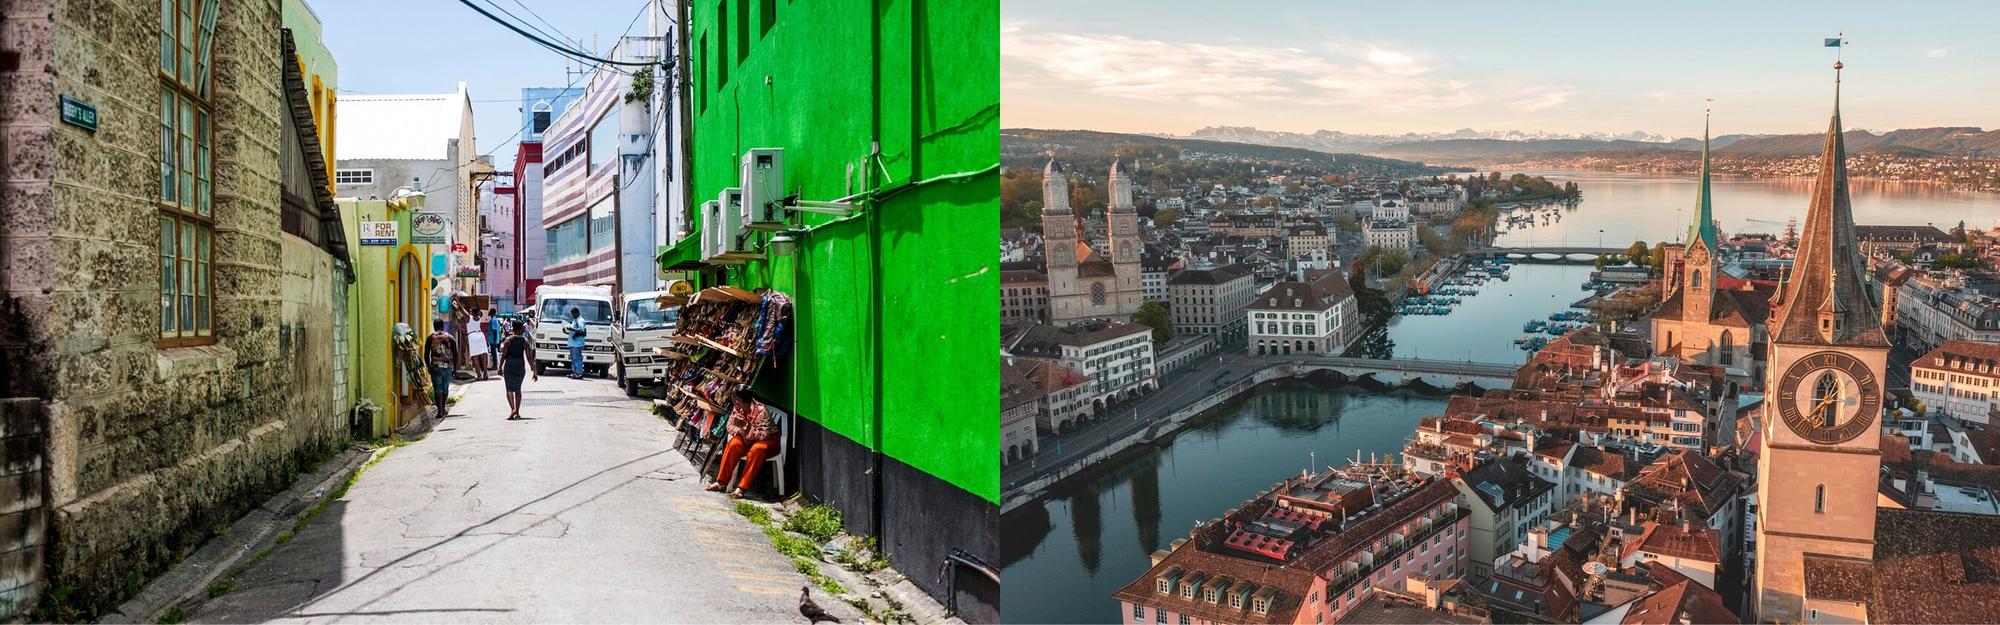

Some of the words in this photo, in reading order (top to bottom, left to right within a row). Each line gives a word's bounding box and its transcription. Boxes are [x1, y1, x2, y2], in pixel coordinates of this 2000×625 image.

[375, 222, 392, 230] FOR
[375, 229, 396, 237] RENT
[1823, 354, 1837, 367] XII
